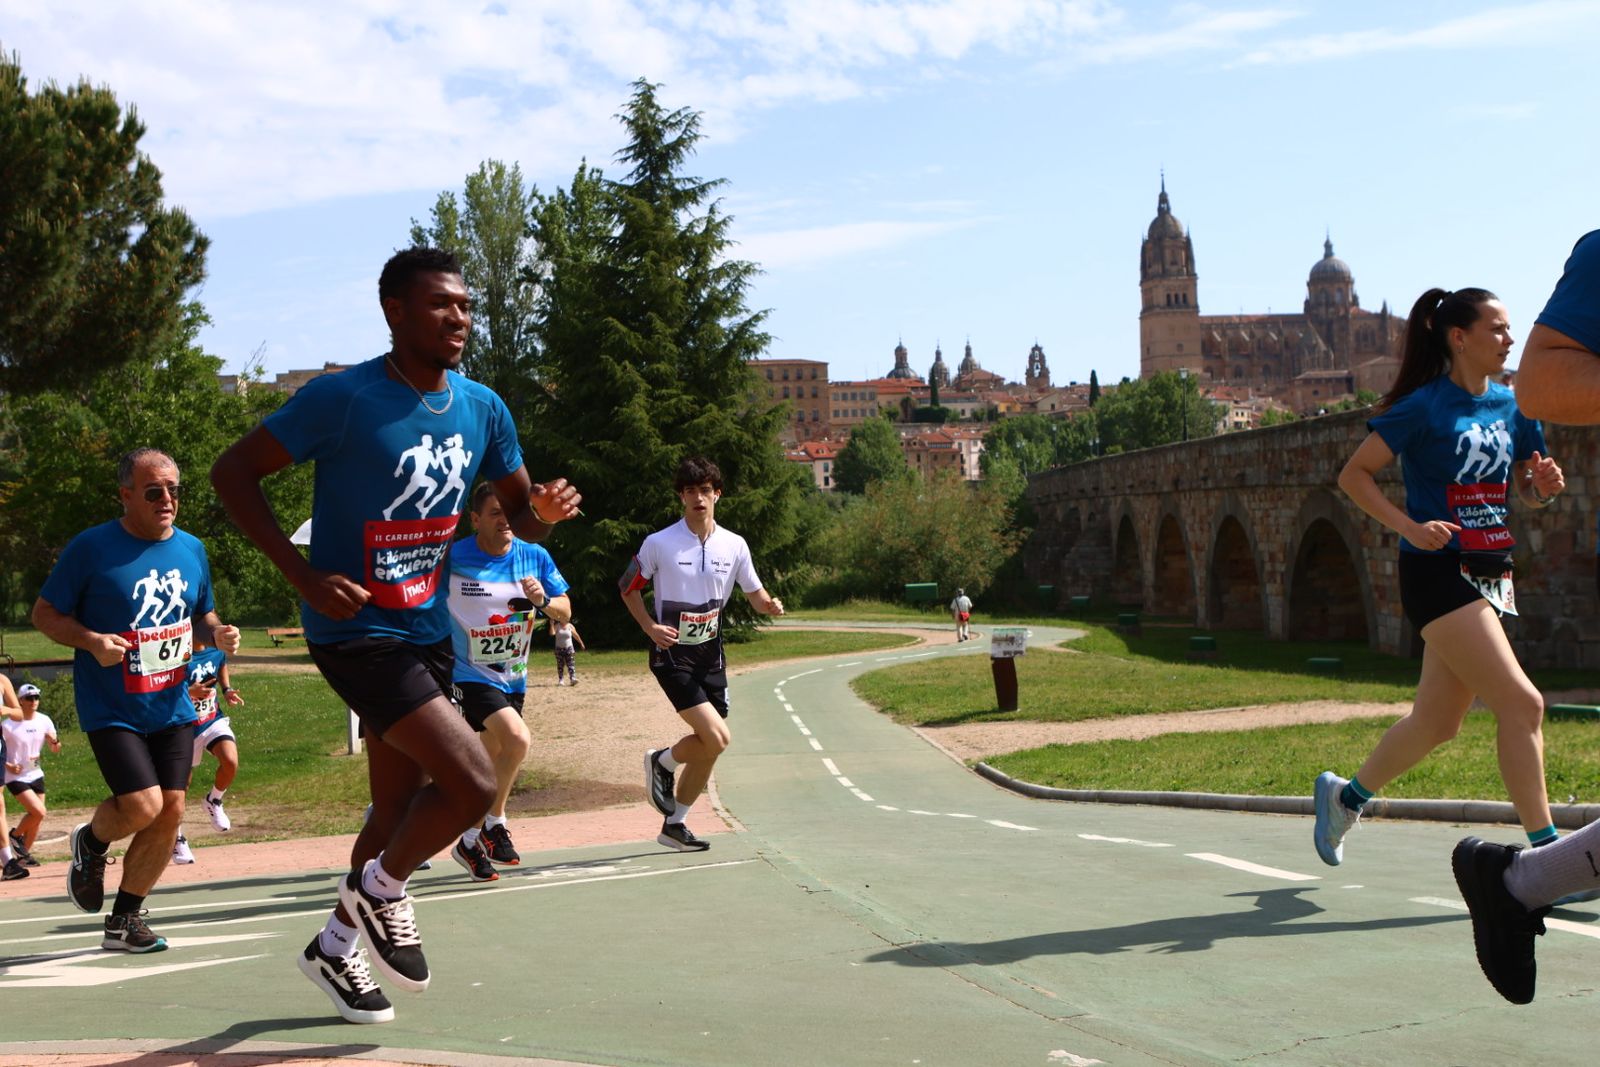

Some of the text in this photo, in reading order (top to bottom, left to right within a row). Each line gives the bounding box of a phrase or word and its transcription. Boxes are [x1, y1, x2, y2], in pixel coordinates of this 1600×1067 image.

[385, 532, 424, 541] CARRERA
[376, 545, 445, 565] kilómetro
[140, 622, 191, 643] bedunia
[470, 624, 521, 638] bedunia
[687, 620, 712, 637] 274
[159, 637, 182, 661] 67
[480, 635, 516, 655] 224
